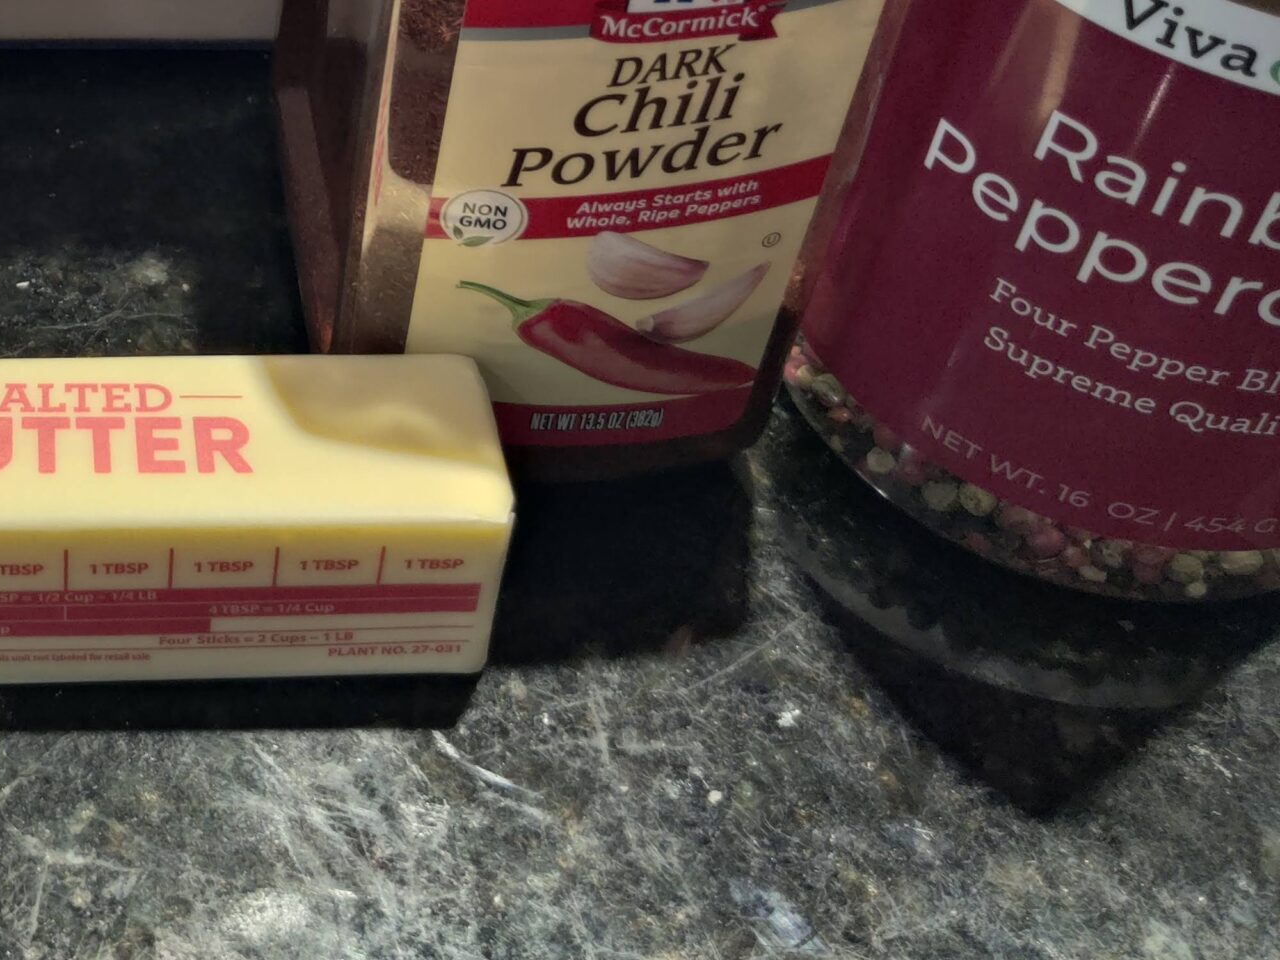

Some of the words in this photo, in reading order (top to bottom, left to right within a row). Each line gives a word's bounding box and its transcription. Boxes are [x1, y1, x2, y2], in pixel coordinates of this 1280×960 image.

[601, 7, 760, 39] McCormick
[607, 43, 737, 88] DARK
[573, 73, 746, 138] Chili
[500, 121, 784, 189] Powder
[576, 197, 647, 217] Always
[653, 187, 713, 208] Starts
[718, 179, 759, 198] with
[461, 201, 509, 218] NON
[566, 210, 631, 230] Whole,
[638, 206, 679, 226] Ripe
[685, 193, 762, 218] Peppers
[458, 213, 507, 231] GMO
[989, 277, 1078, 338] Four
[1084, 325, 1231, 387] Pepper
[984, 326, 1157, 415] Supreme
[530, 412, 556, 431] NET
[557, 412, 577, 431] WT
[580, 412, 606, 430] 13.5
[607, 411, 625, 429] OZ
[625, 407, 665, 430] (382g)
[922, 415, 983, 460] NET
[990, 453, 1048, 496] WT.
[1058, 483, 1091, 508] 16
[1108, 501, 1160, 526] OZ
[1184, 515, 1246, 535] 454
[101, 562, 150, 575] TBSP
[206, 561, 255, 574] TBSP
[311, 559, 360, 572] TBSP
[415, 558, 465, 571] TBSP
[64, 592, 94, 604] Cup
[306, 602, 335, 614] Cup
[270, 632, 307, 645] Cups
[335, 631, 354, 641] LB
[328, 645, 377, 657] PLANT
[381, 644, 407, 656] NO.
